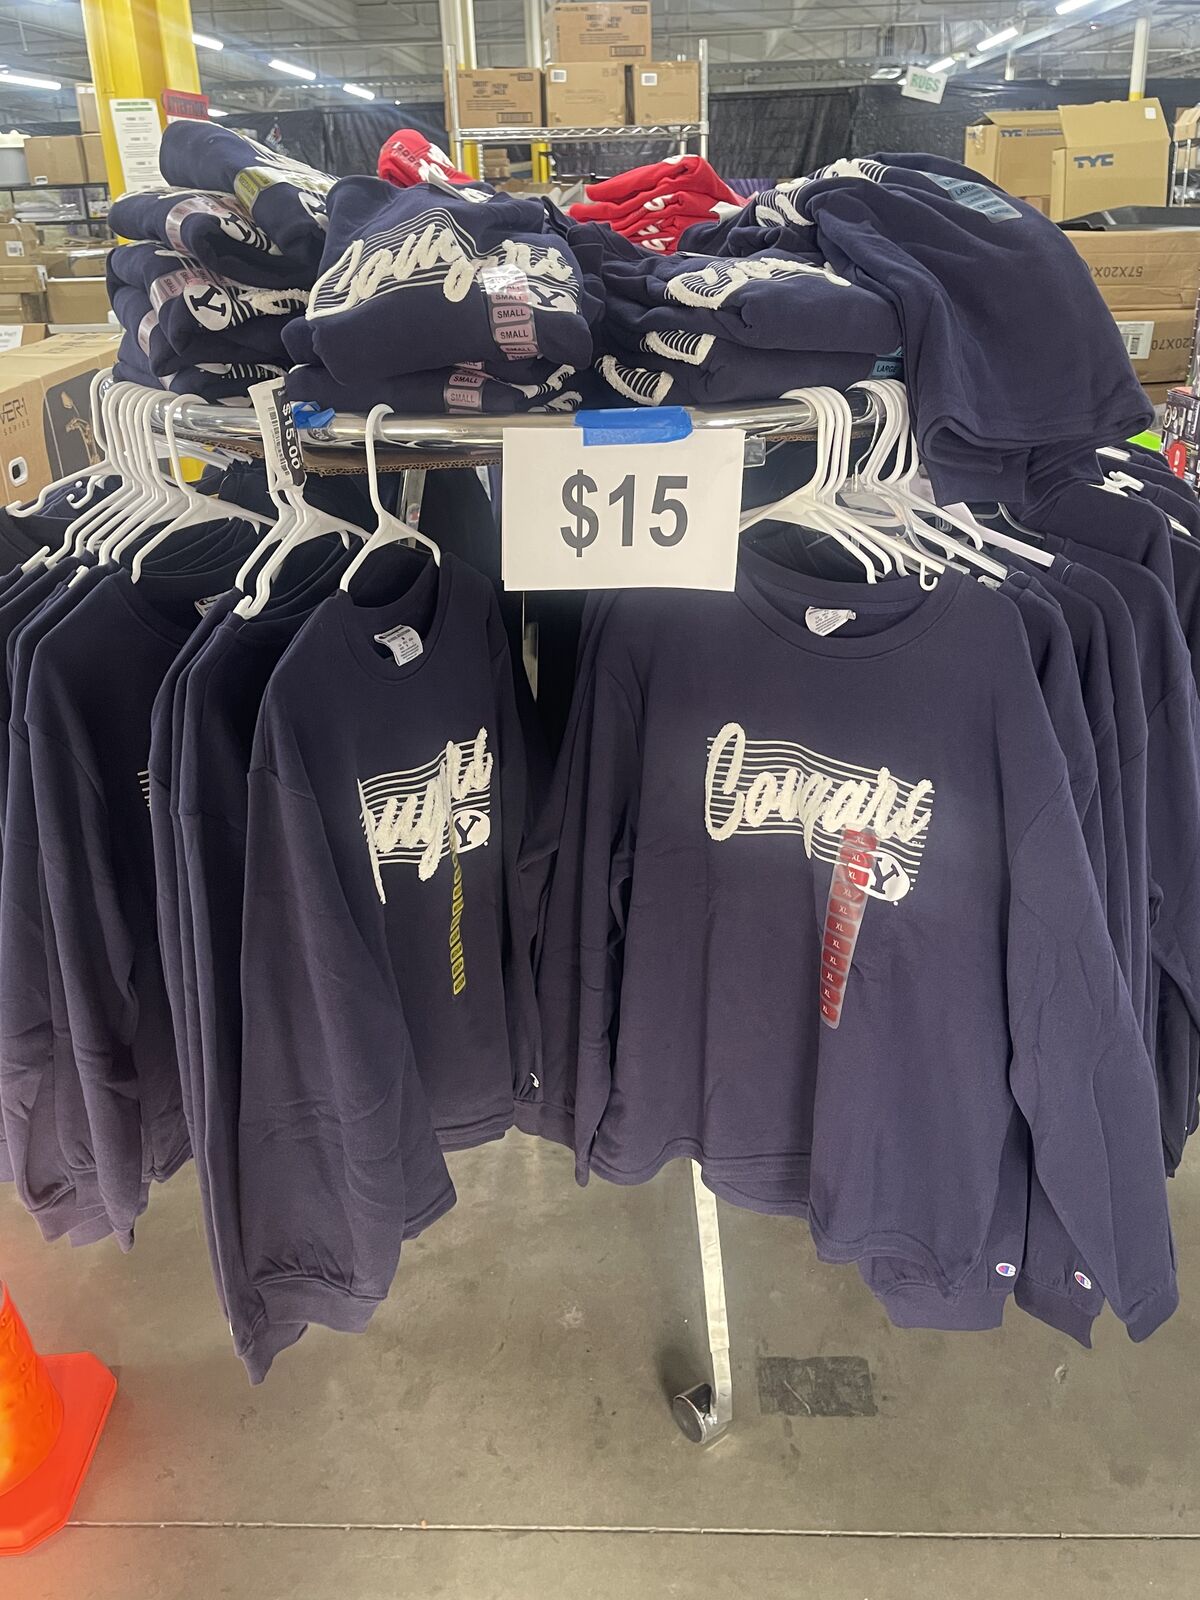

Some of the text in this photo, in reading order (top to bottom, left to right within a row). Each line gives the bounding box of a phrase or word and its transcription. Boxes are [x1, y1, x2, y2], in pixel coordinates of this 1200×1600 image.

[911, 73, 941, 92] RUGS
[1074, 154, 1114, 168] TYC
[497, 308, 526, 319] SMALL
[500, 329, 529, 340] SMALL
[453, 375, 479, 384] SMALL
[450, 392, 475, 404] SMALL
[282, 402, 301, 470] $15.00
[560, 469, 689, 558] $15
[851, 853, 861, 862] XL
[848, 871, 857, 880] XL
[839, 905, 848, 914] XL
[835, 922, 844, 932] XL
[832, 939, 840, 949] XL
[829, 955, 837, 965] XL
[826, 972, 834, 982] XL
[824, 989, 831, 999] XL
[822, 1005, 829, 1015] XL
